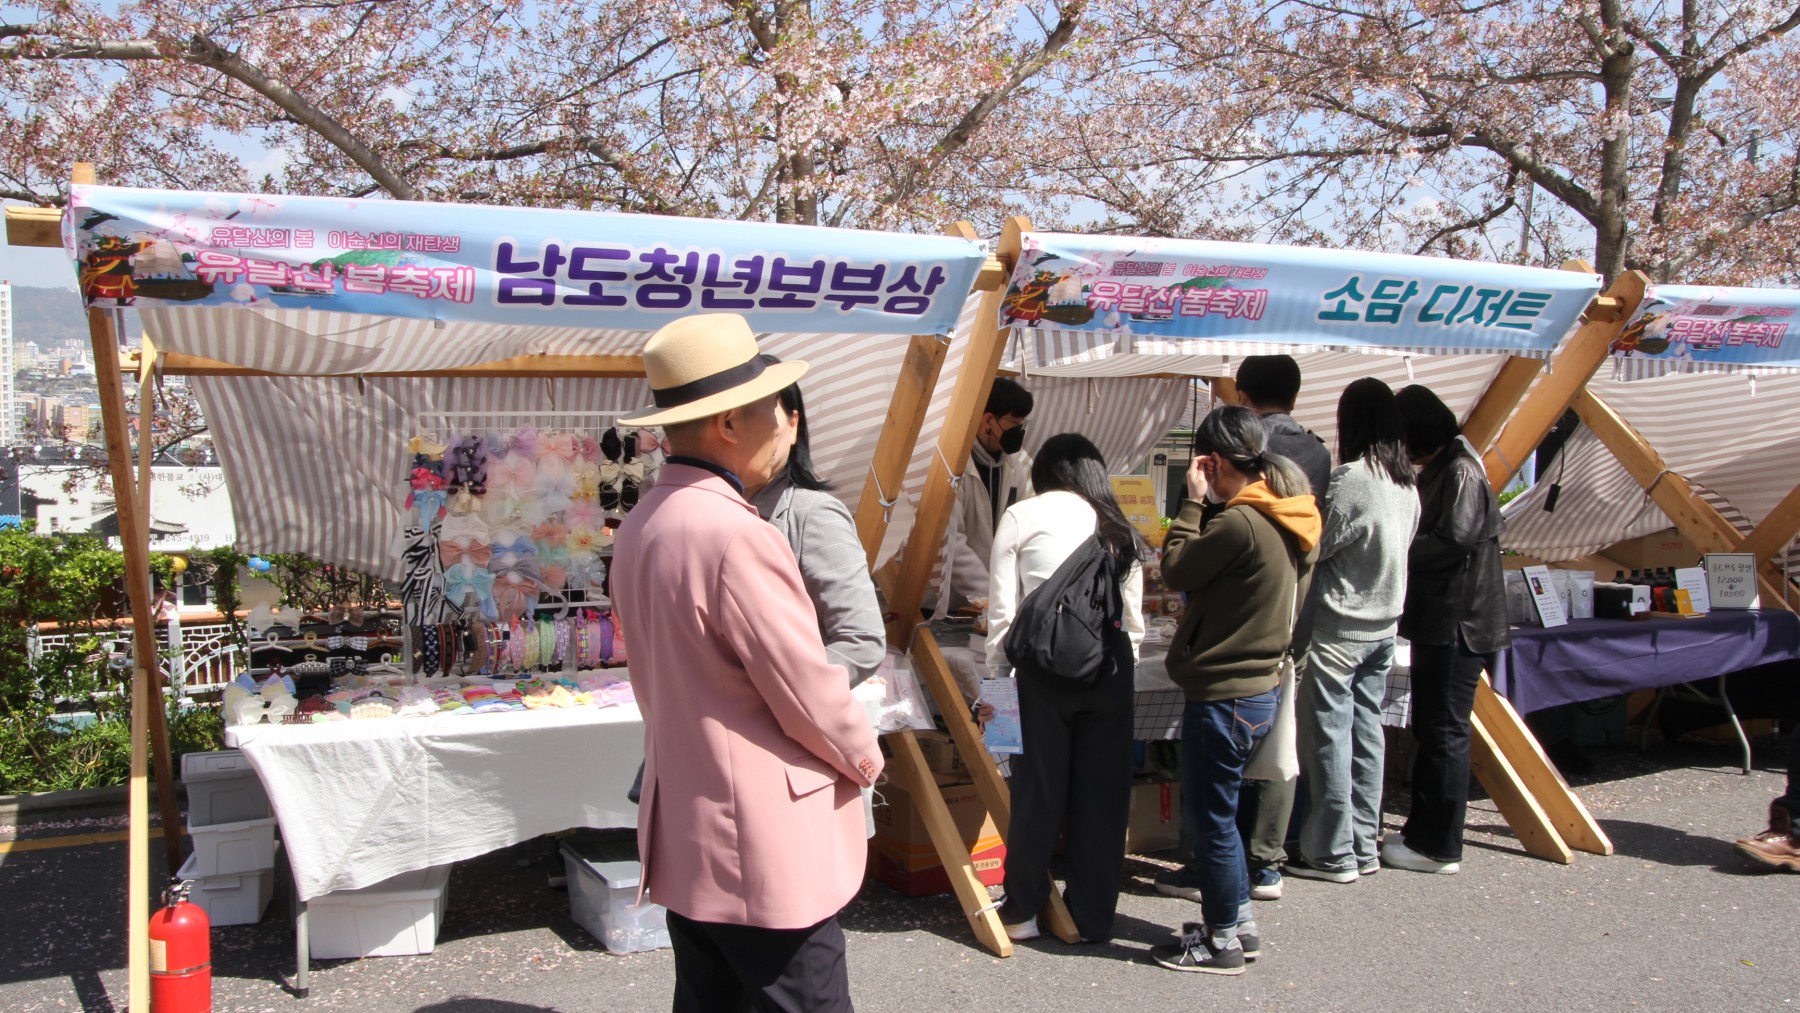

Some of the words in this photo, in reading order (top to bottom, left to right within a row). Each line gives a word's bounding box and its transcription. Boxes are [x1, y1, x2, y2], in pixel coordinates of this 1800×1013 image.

[211, 227, 290, 250] 유달산의
[294, 228, 315, 250] 봄
[328, 229, 404, 252] 이순신의
[405, 233, 461, 253] 재탄생
[197, 250, 337, 292] 유달산
[344, 263, 476, 304] 봄축제
[495, 240, 947, 315] 남도청년보부상
[1183, 264, 1231, 279] 이순신의
[1232, 265, 1268, 280] 재탄생
[1088, 281, 1179, 316] 유달산
[1179, 287, 1268, 320] 봄축제
[1317, 275, 1419, 325] 소담
[1417, 284, 1553, 331] 디저트
[1668, 318, 1731, 346] 유달산
[1725, 321, 1789, 348] 봄축제
